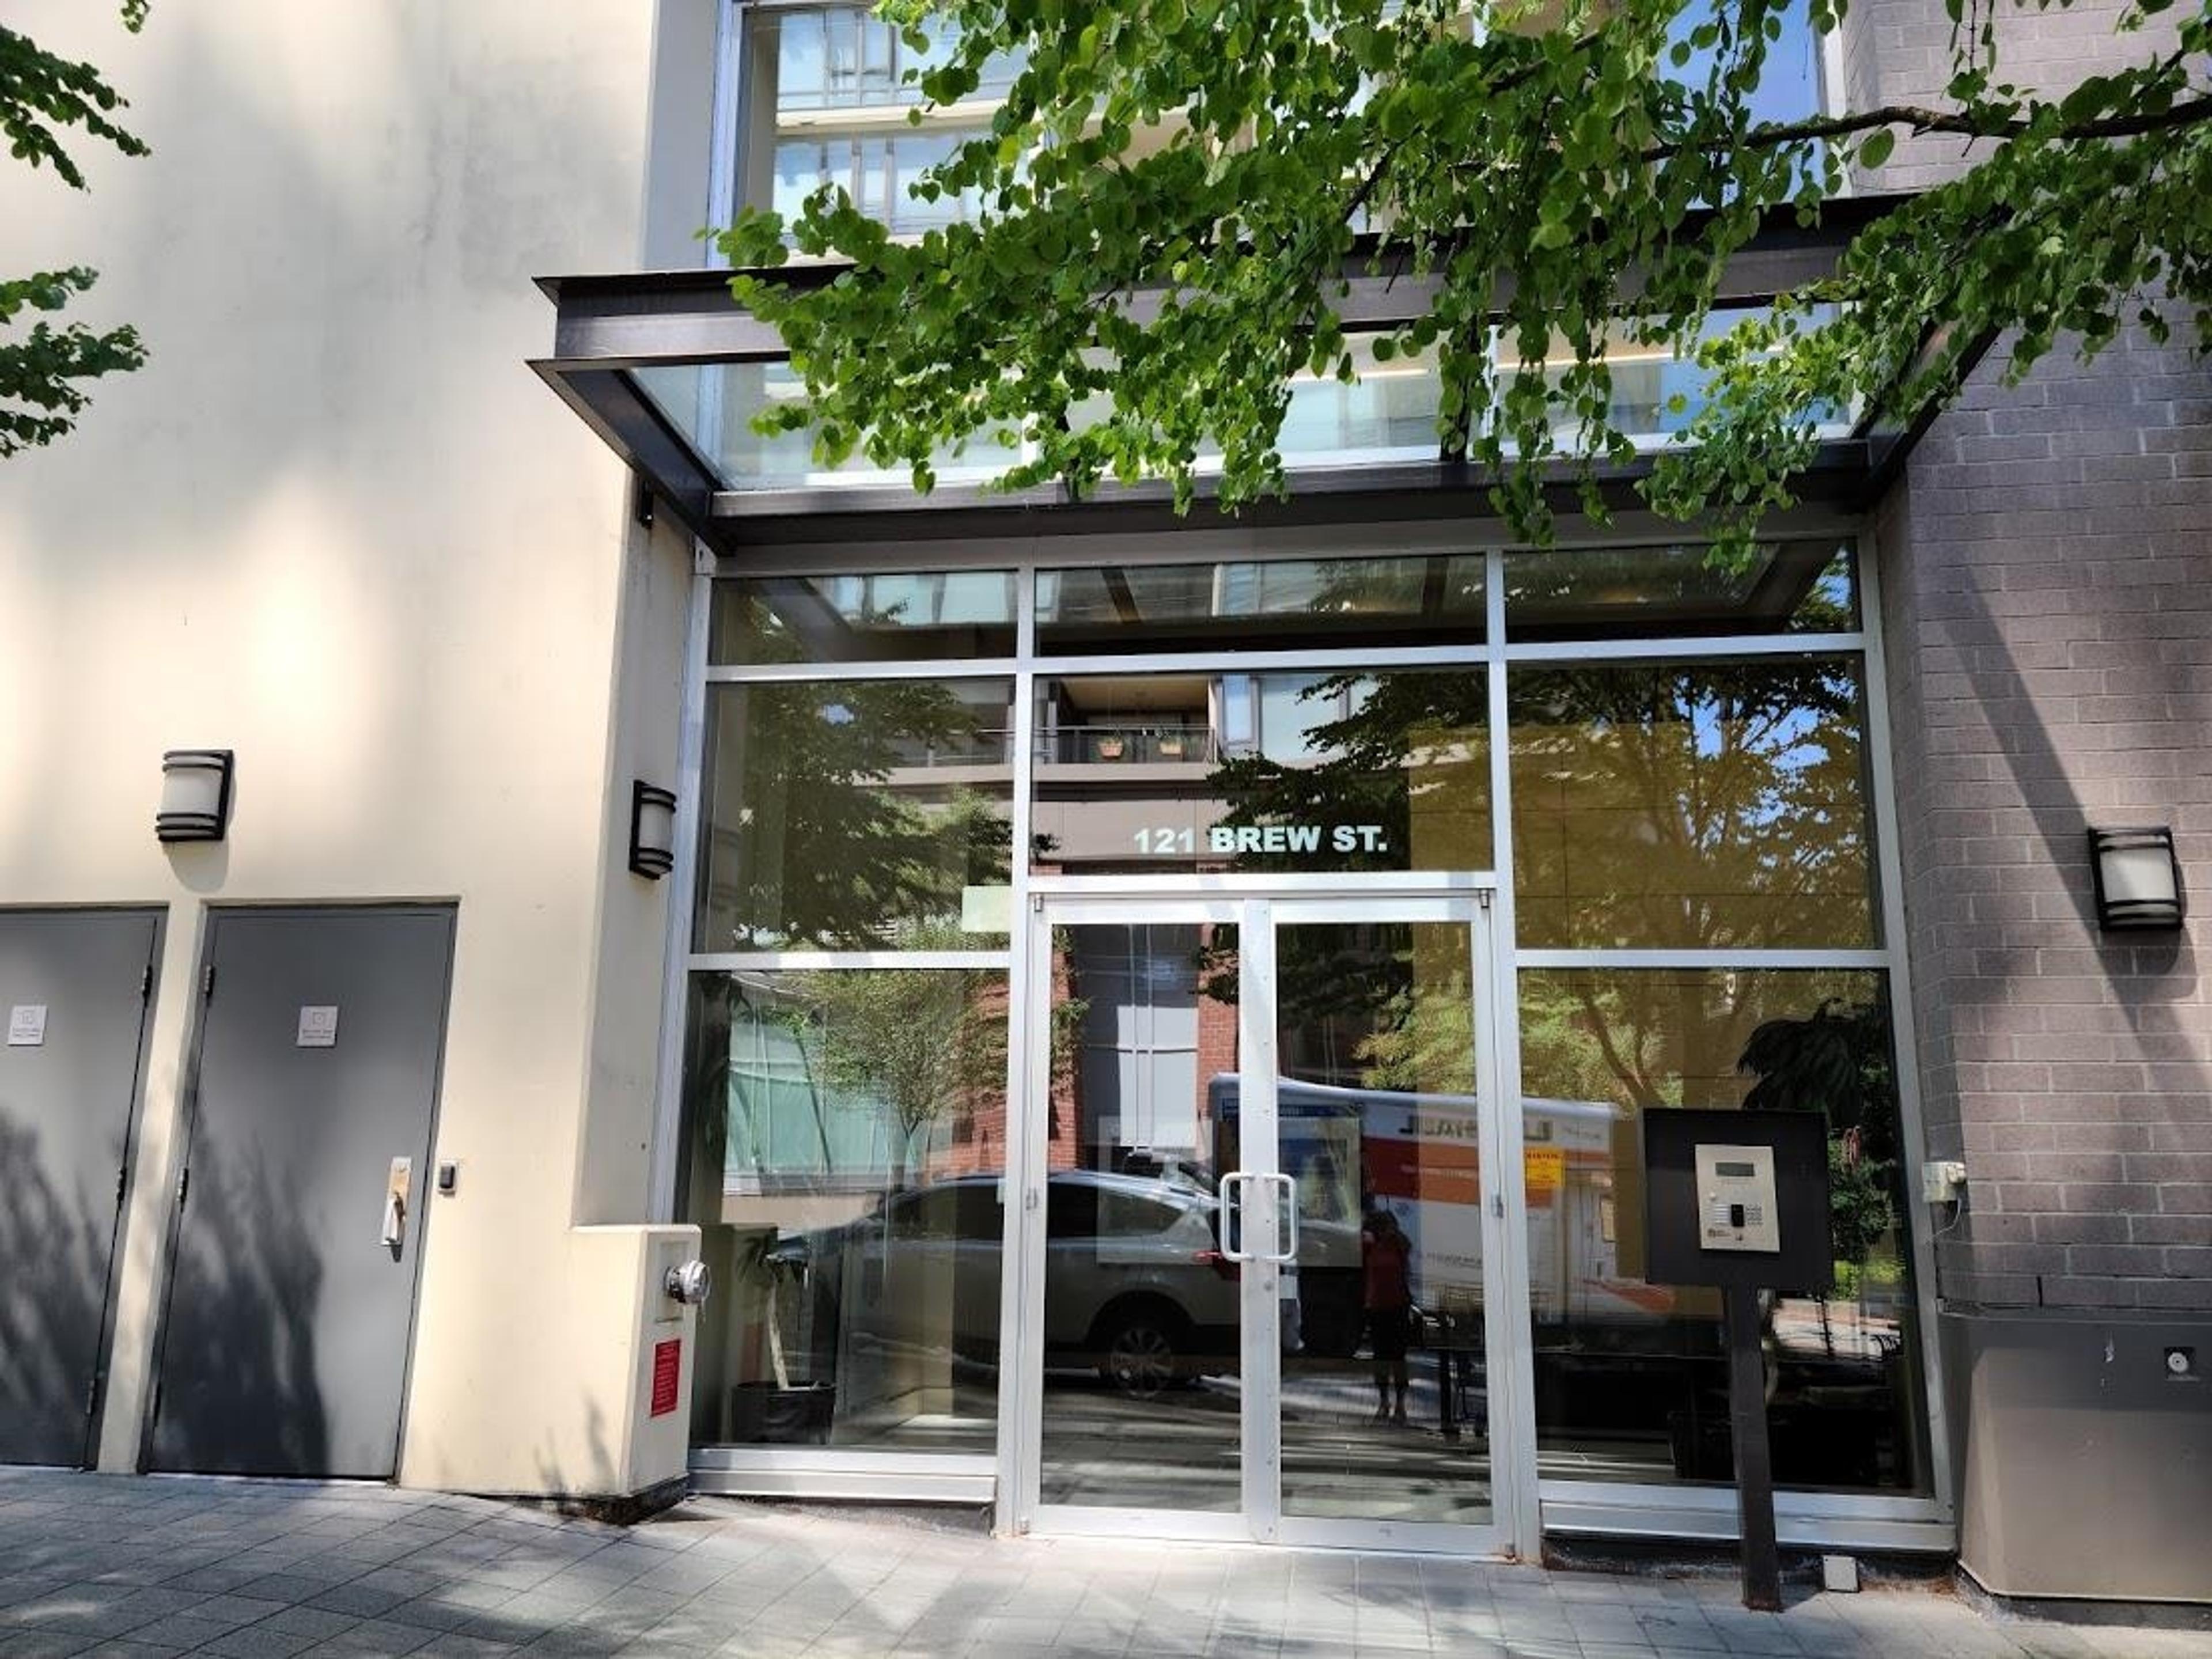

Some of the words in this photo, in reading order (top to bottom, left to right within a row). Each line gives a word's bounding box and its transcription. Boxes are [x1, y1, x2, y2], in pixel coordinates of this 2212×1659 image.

[1134, 828, 1194, 854] 121
[1210, 825, 1321, 853] BREW
[1332, 825, 1387, 851] ST.
